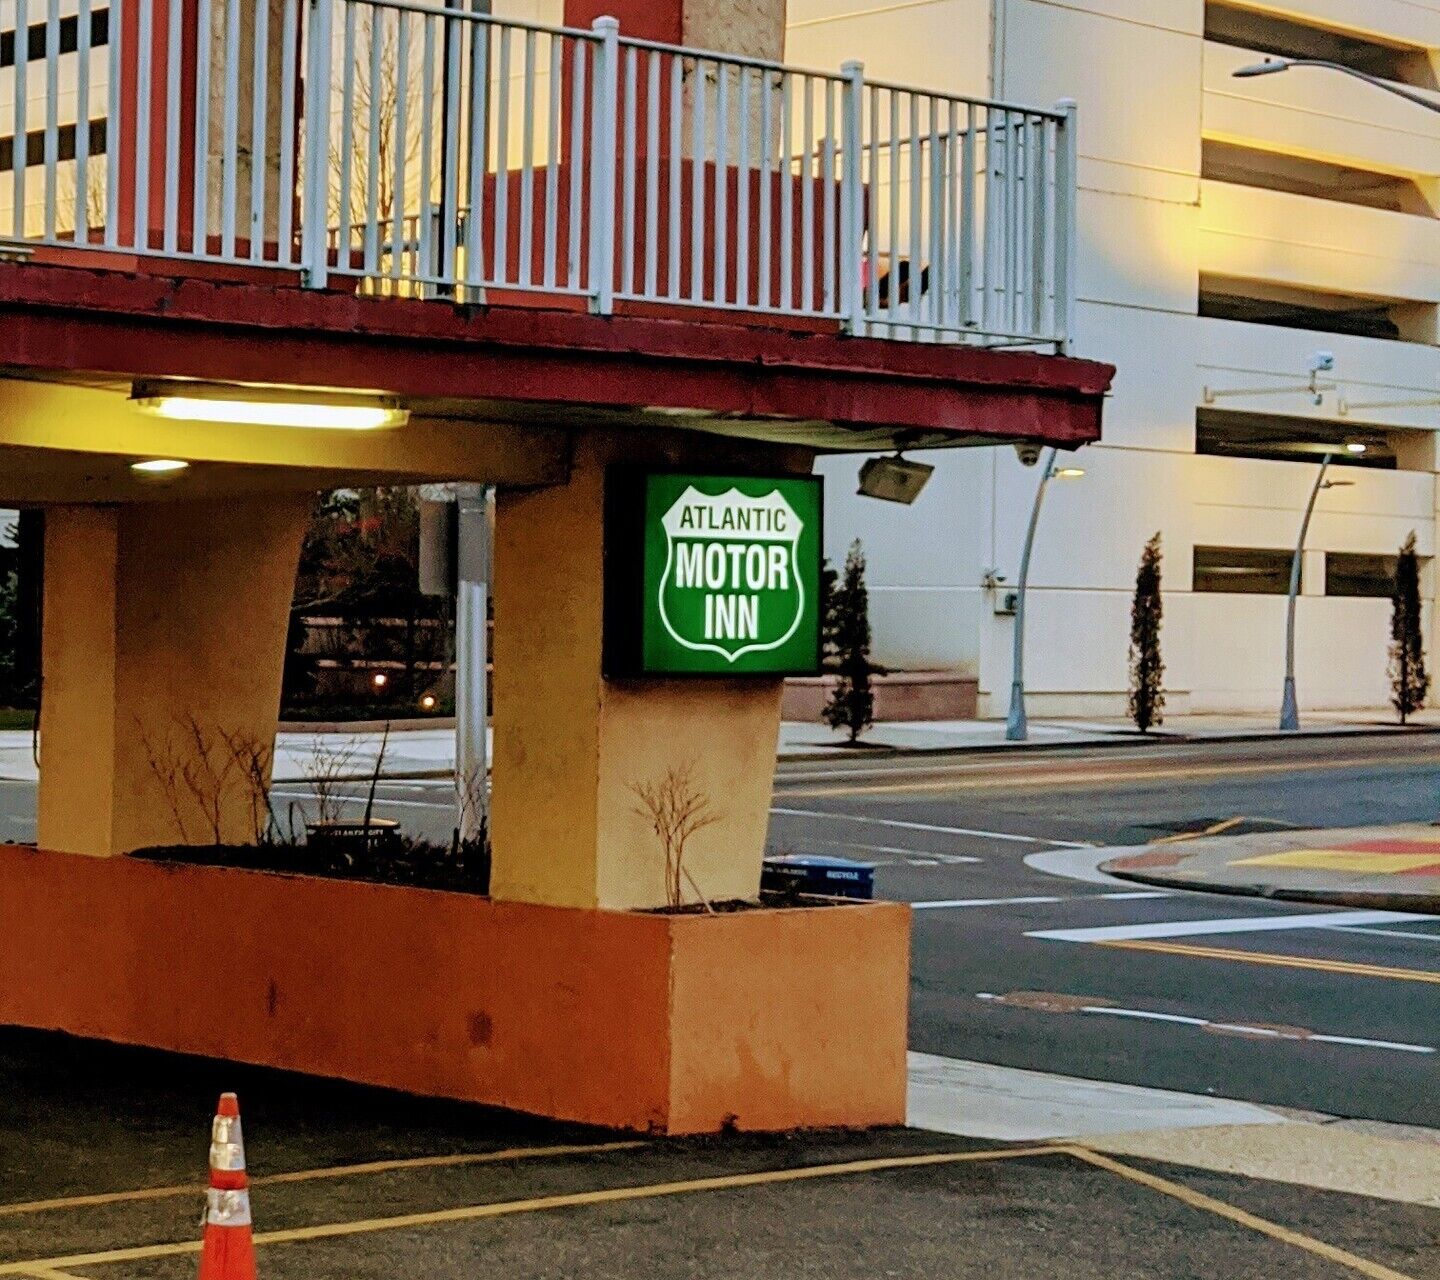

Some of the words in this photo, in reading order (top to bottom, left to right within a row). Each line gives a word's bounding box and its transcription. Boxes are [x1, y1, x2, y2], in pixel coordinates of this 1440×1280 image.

[679, 505, 787, 533] ATLANTIC
[675, 542, 790, 591] MOTOR
[704, 593, 759, 640] INN
